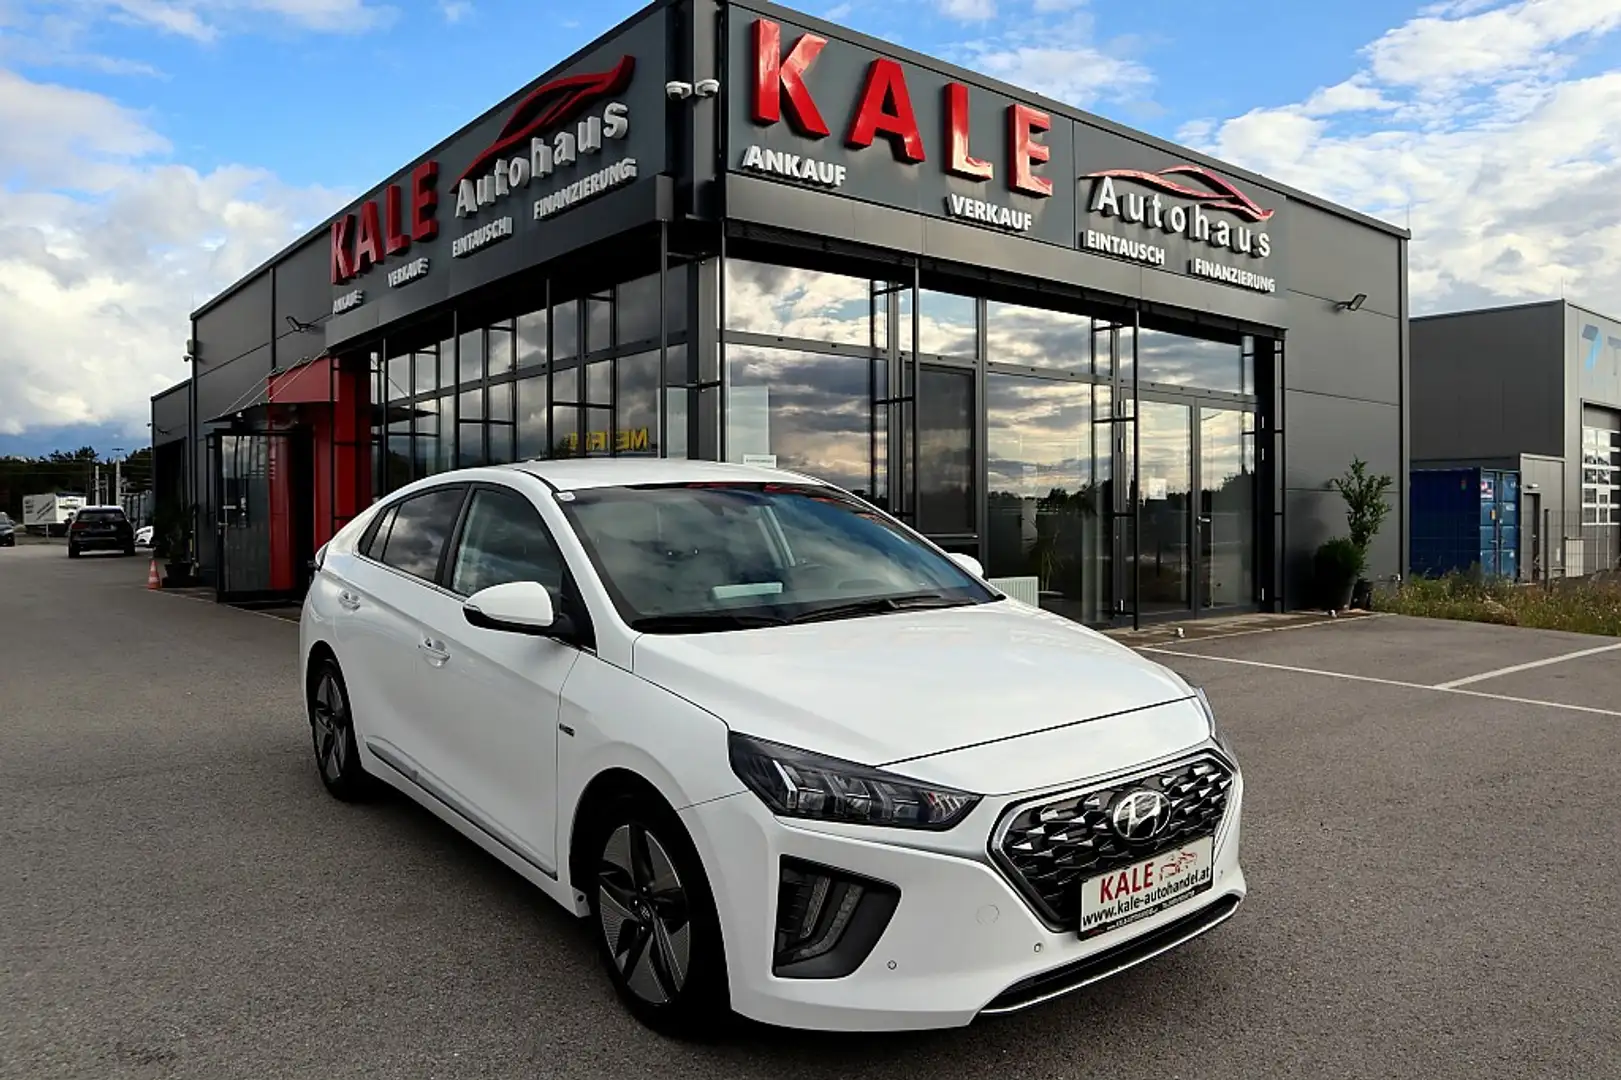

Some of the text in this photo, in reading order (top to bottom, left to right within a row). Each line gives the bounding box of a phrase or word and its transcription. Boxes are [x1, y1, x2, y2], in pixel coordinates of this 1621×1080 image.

[330, 101, 629, 285] KALE Autohaus
[750, 17, 1271, 258] KALE Autohaus
[387, 257, 429, 288] VERKAUF
[452, 216, 513, 258] EINTAUSCH
[533, 157, 638, 220] FINANZIERUNG
[742, 144, 1276, 293] ANKAUF VERKAUF EINTAUSCH FINANZIERUNG
[1082, 866, 1210, 927] www.kale-autohandel.at
[1099, 861, 1154, 904] KALE
